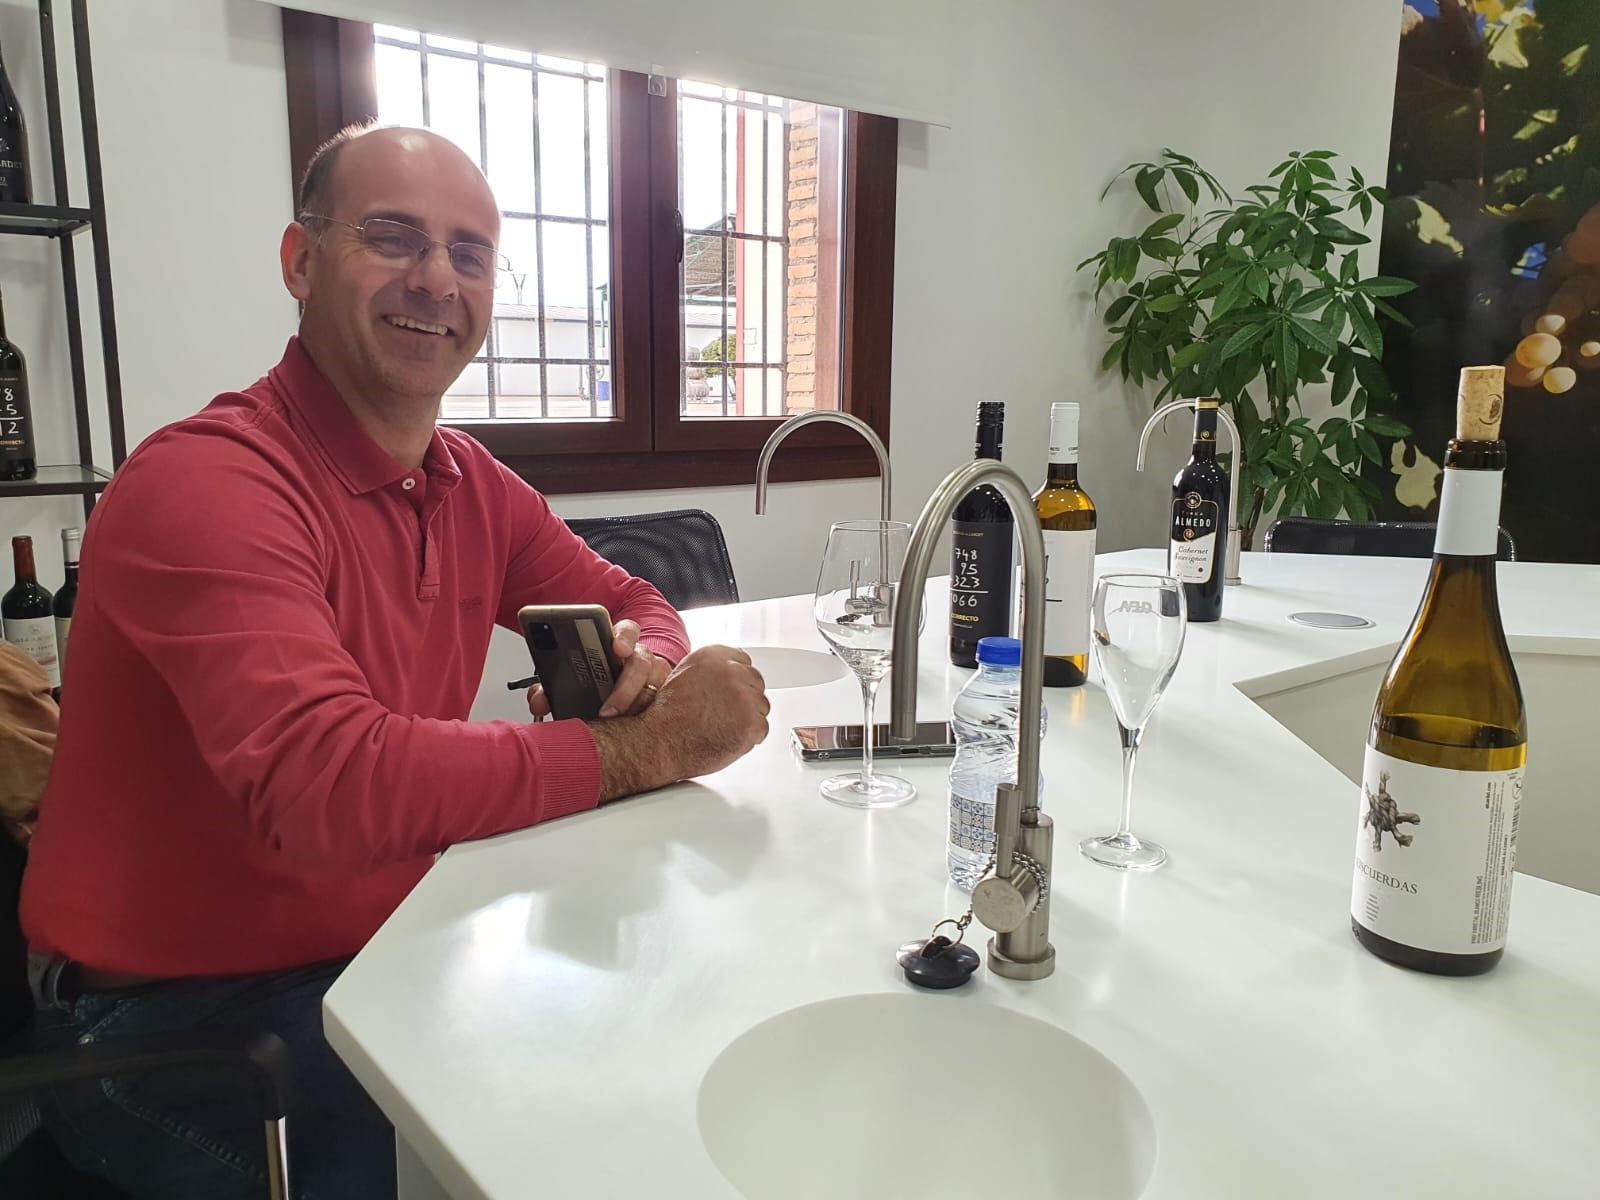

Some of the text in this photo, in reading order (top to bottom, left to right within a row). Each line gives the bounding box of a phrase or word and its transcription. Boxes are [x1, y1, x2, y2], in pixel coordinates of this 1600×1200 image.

[1175, 515, 1211, 527] ALMEDO
[954, 547, 978, 561] 748
[1178, 545, 1209, 555] Cabernet
[960, 562, 978, 575] 95
[953, 575, 980, 588] 323
